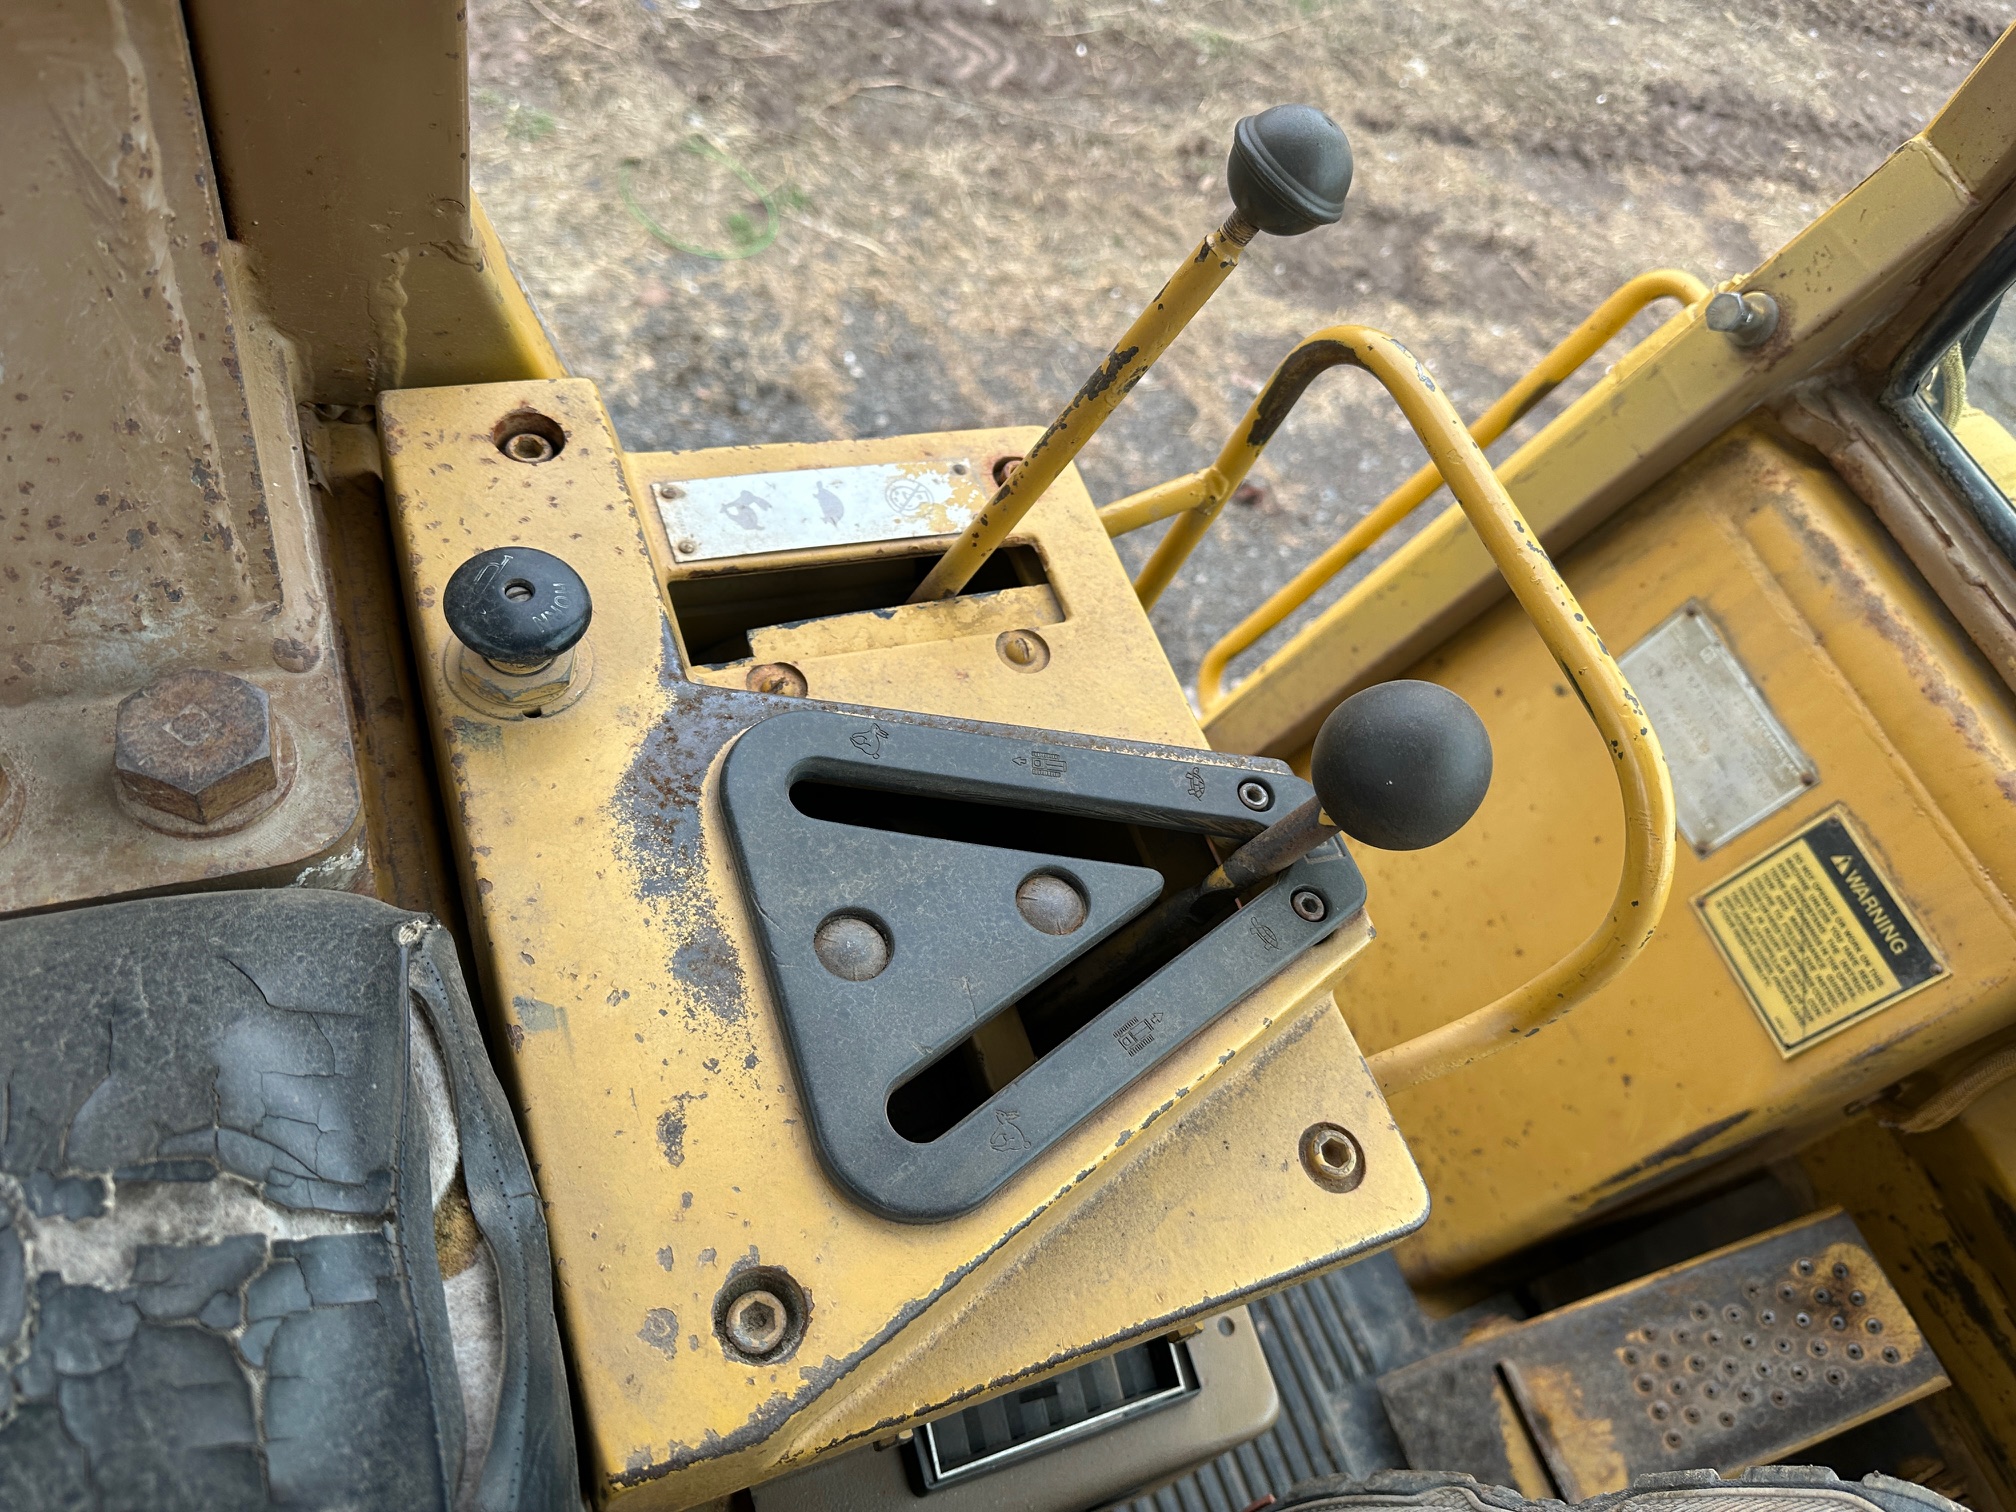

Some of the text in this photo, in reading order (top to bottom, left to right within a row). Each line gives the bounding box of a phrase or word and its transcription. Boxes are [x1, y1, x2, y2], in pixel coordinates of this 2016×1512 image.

[1800, 863, 1815, 881] NOT
[1811, 880, 1838, 916] OPERATE
[1842, 928, 1862, 954] WORK
[1867, 968, 1885, 988] THIS
[1842, 867, 1910, 956] WARNING
[1825, 938, 1840, 955] THE
[1828, 925, 1844, 943] YOU
[1841, 944, 1859, 967] HAVE
